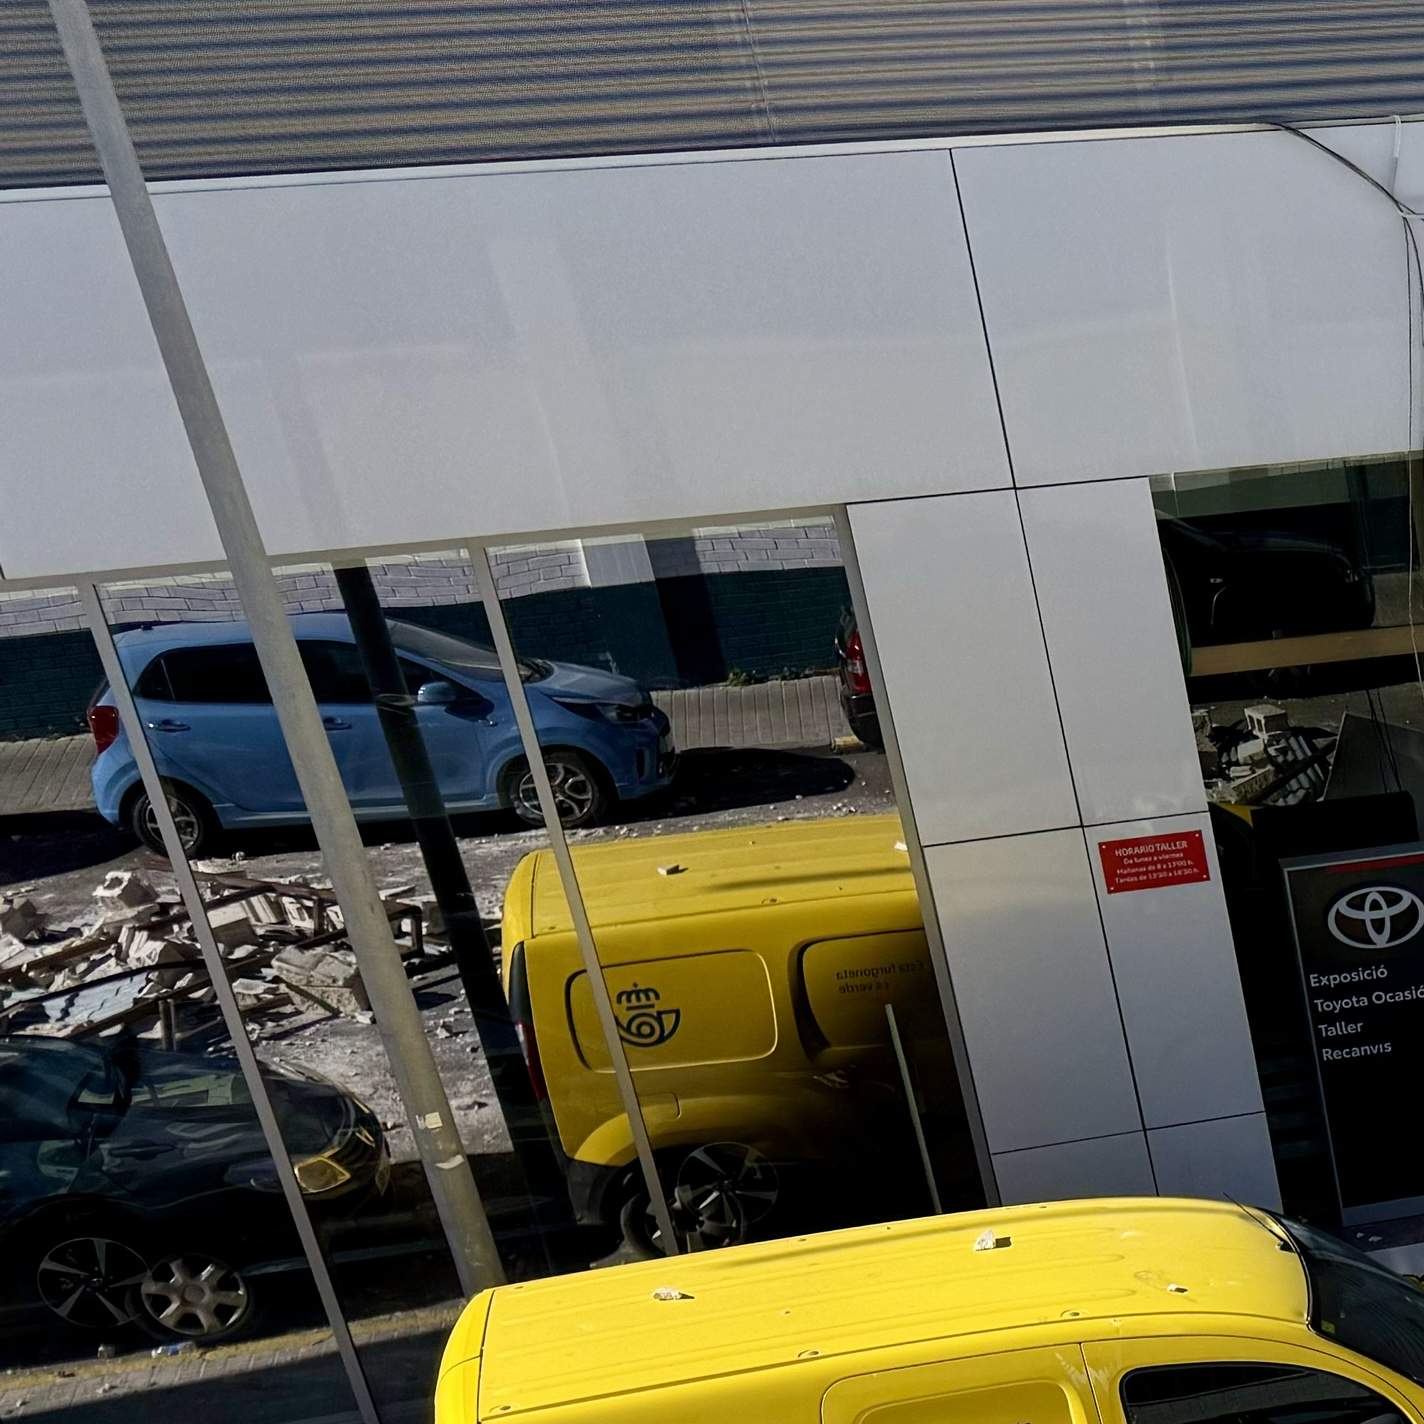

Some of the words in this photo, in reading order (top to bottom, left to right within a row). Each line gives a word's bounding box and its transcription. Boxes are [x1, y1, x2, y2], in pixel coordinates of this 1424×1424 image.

[1115, 845, 1155, 857] HORARIO
[1156, 841, 1189, 851] TALLER
[1310, 965, 1388, 988] Exposició
[1314, 994, 1368, 1013] Toyota
[1318, 1021, 1363, 1038] Taller
[1322, 1042, 1392, 1061] Recanvis
